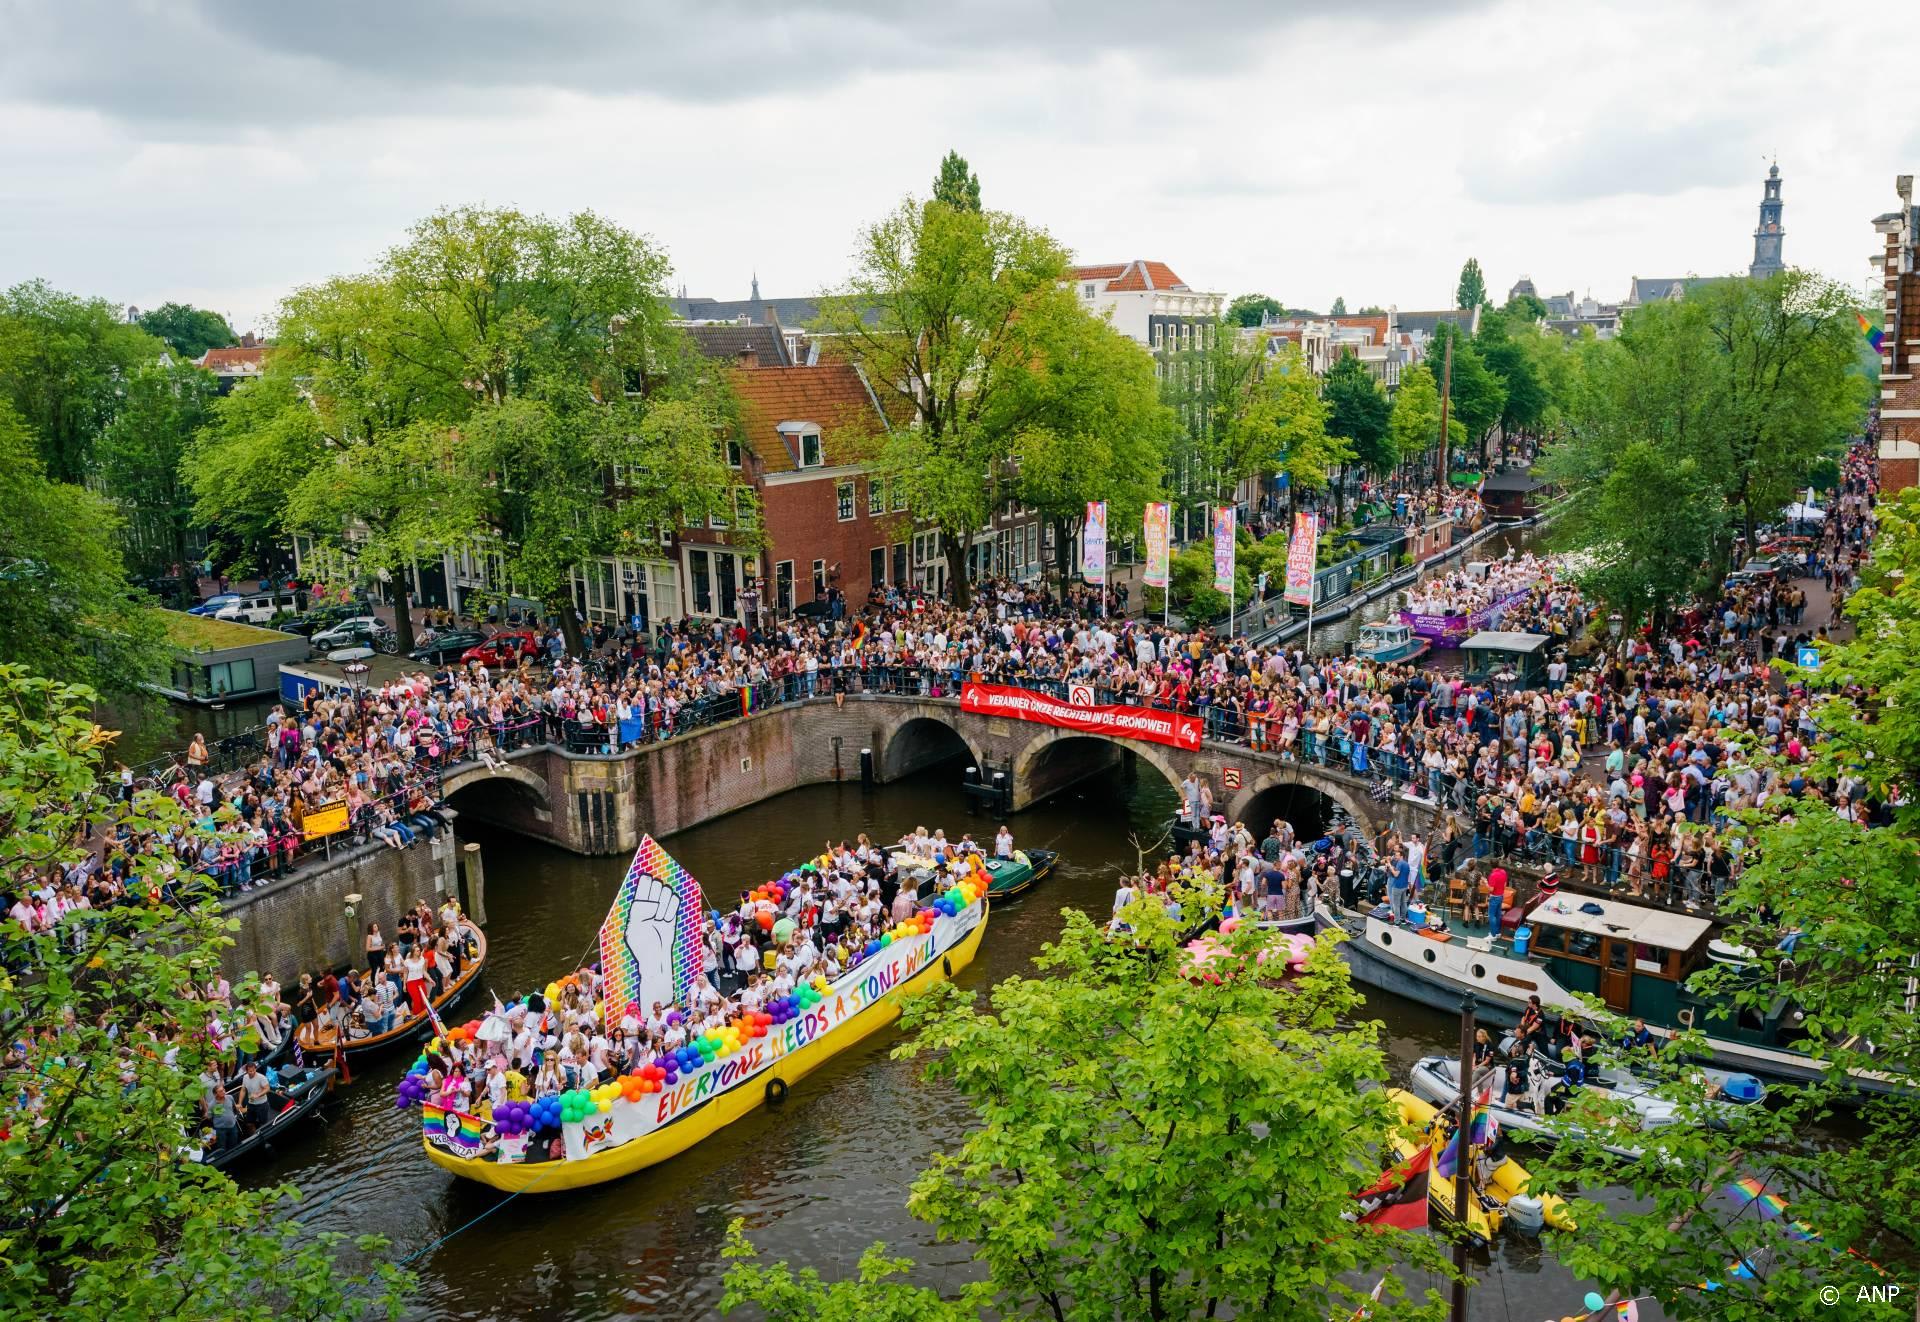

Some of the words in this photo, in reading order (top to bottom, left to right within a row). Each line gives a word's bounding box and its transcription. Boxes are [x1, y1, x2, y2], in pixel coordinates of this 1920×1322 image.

[989, 694, 1029, 710] VERANKER
[1030, 701, 1053, 715] ONZE
[1053, 705, 1091, 722] RECHTEN
[1092, 712, 1102, 723] IN
[1103, 713, 1115, 725] DE
[1116, 715, 1171, 734] GRONDWET!
[320, 801, 345, 811] msterdam
[656, 1043, 763, 1123] EVERYONE
[771, 1004, 829, 1060] NEEDS
[834, 995, 847, 1021] A
[850, 960, 900, 1011] STONE
[905, 935, 936, 976] WALL
